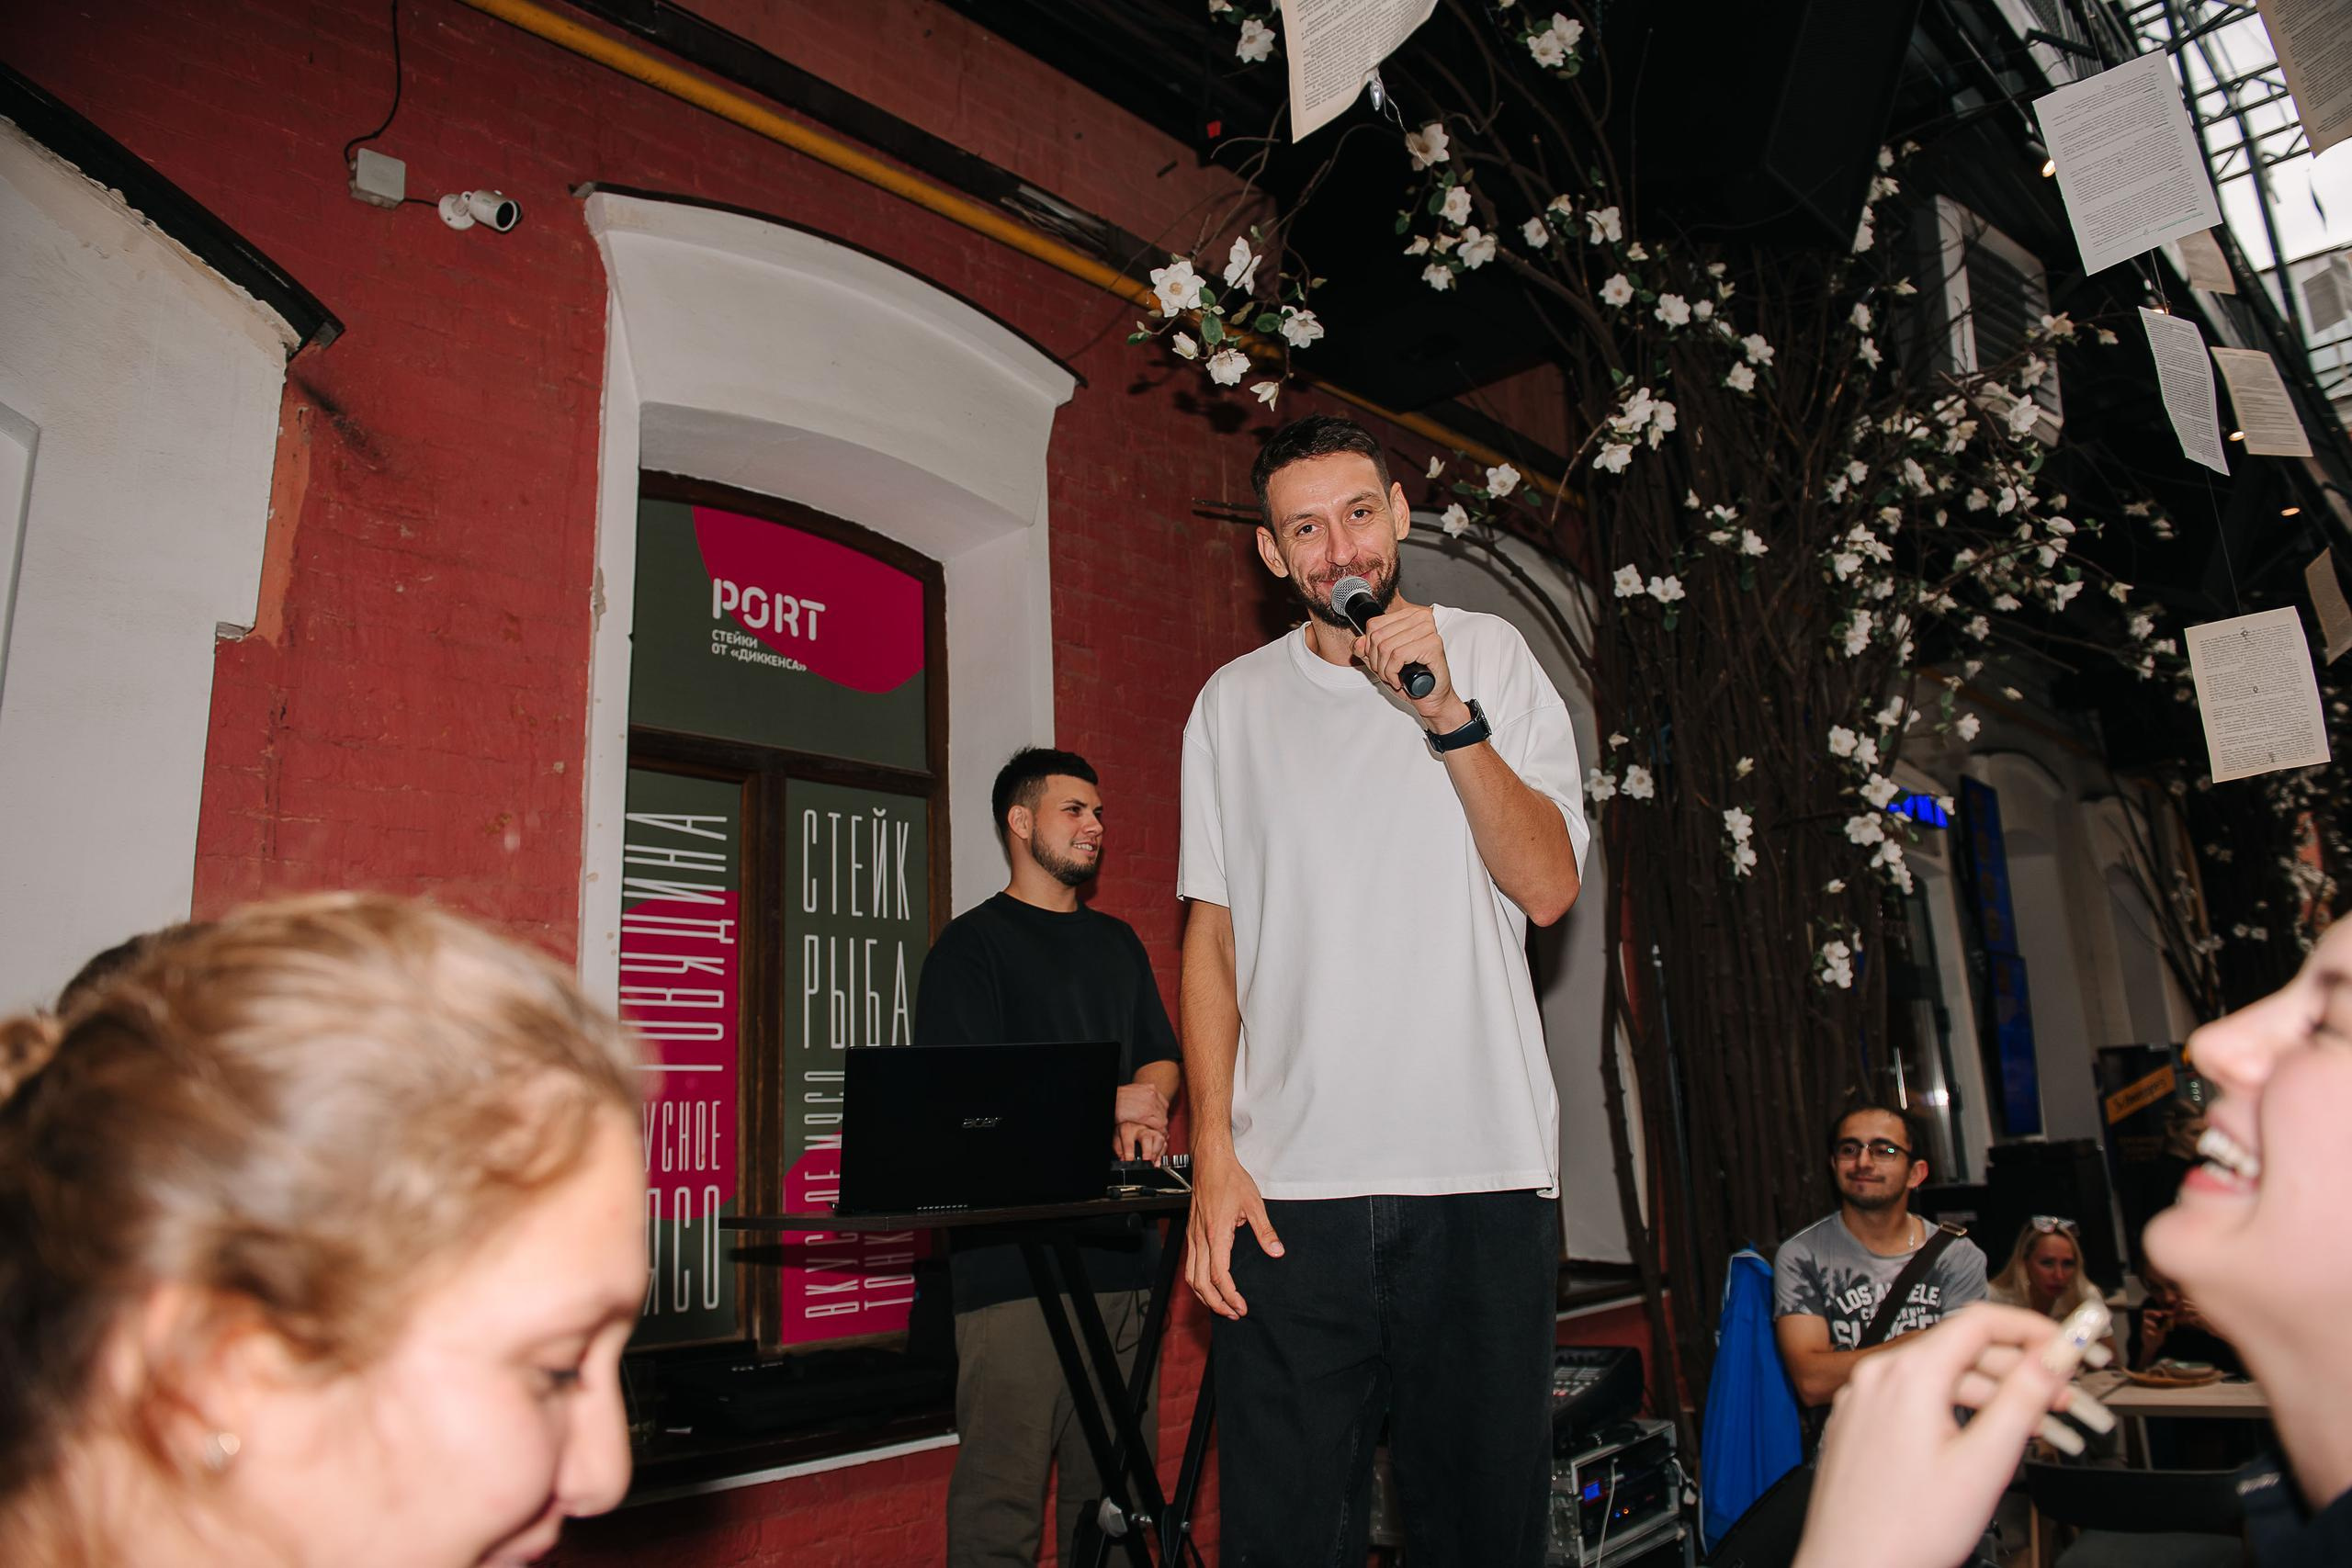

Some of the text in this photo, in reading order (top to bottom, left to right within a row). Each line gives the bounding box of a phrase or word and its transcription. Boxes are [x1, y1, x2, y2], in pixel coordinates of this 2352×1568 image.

[711, 629, 758, 649] СТЕЙКИ
[712, 577, 826, 641] PORT
[711, 642, 807, 671] ОТ «ДИККЕНСА»
[803, 807, 910, 920] СТЕЙК
[803, 934, 911, 1049] РЫБА
[643, 1100, 721, 1173] УСНОЕ
[962, 1116, 1002, 1129] acer
[643, 1185, 720, 1316] ЯСО
[804, 1170, 860, 1319] ВКУСОЕ
[1836, 1284, 1873, 1315] LOS
